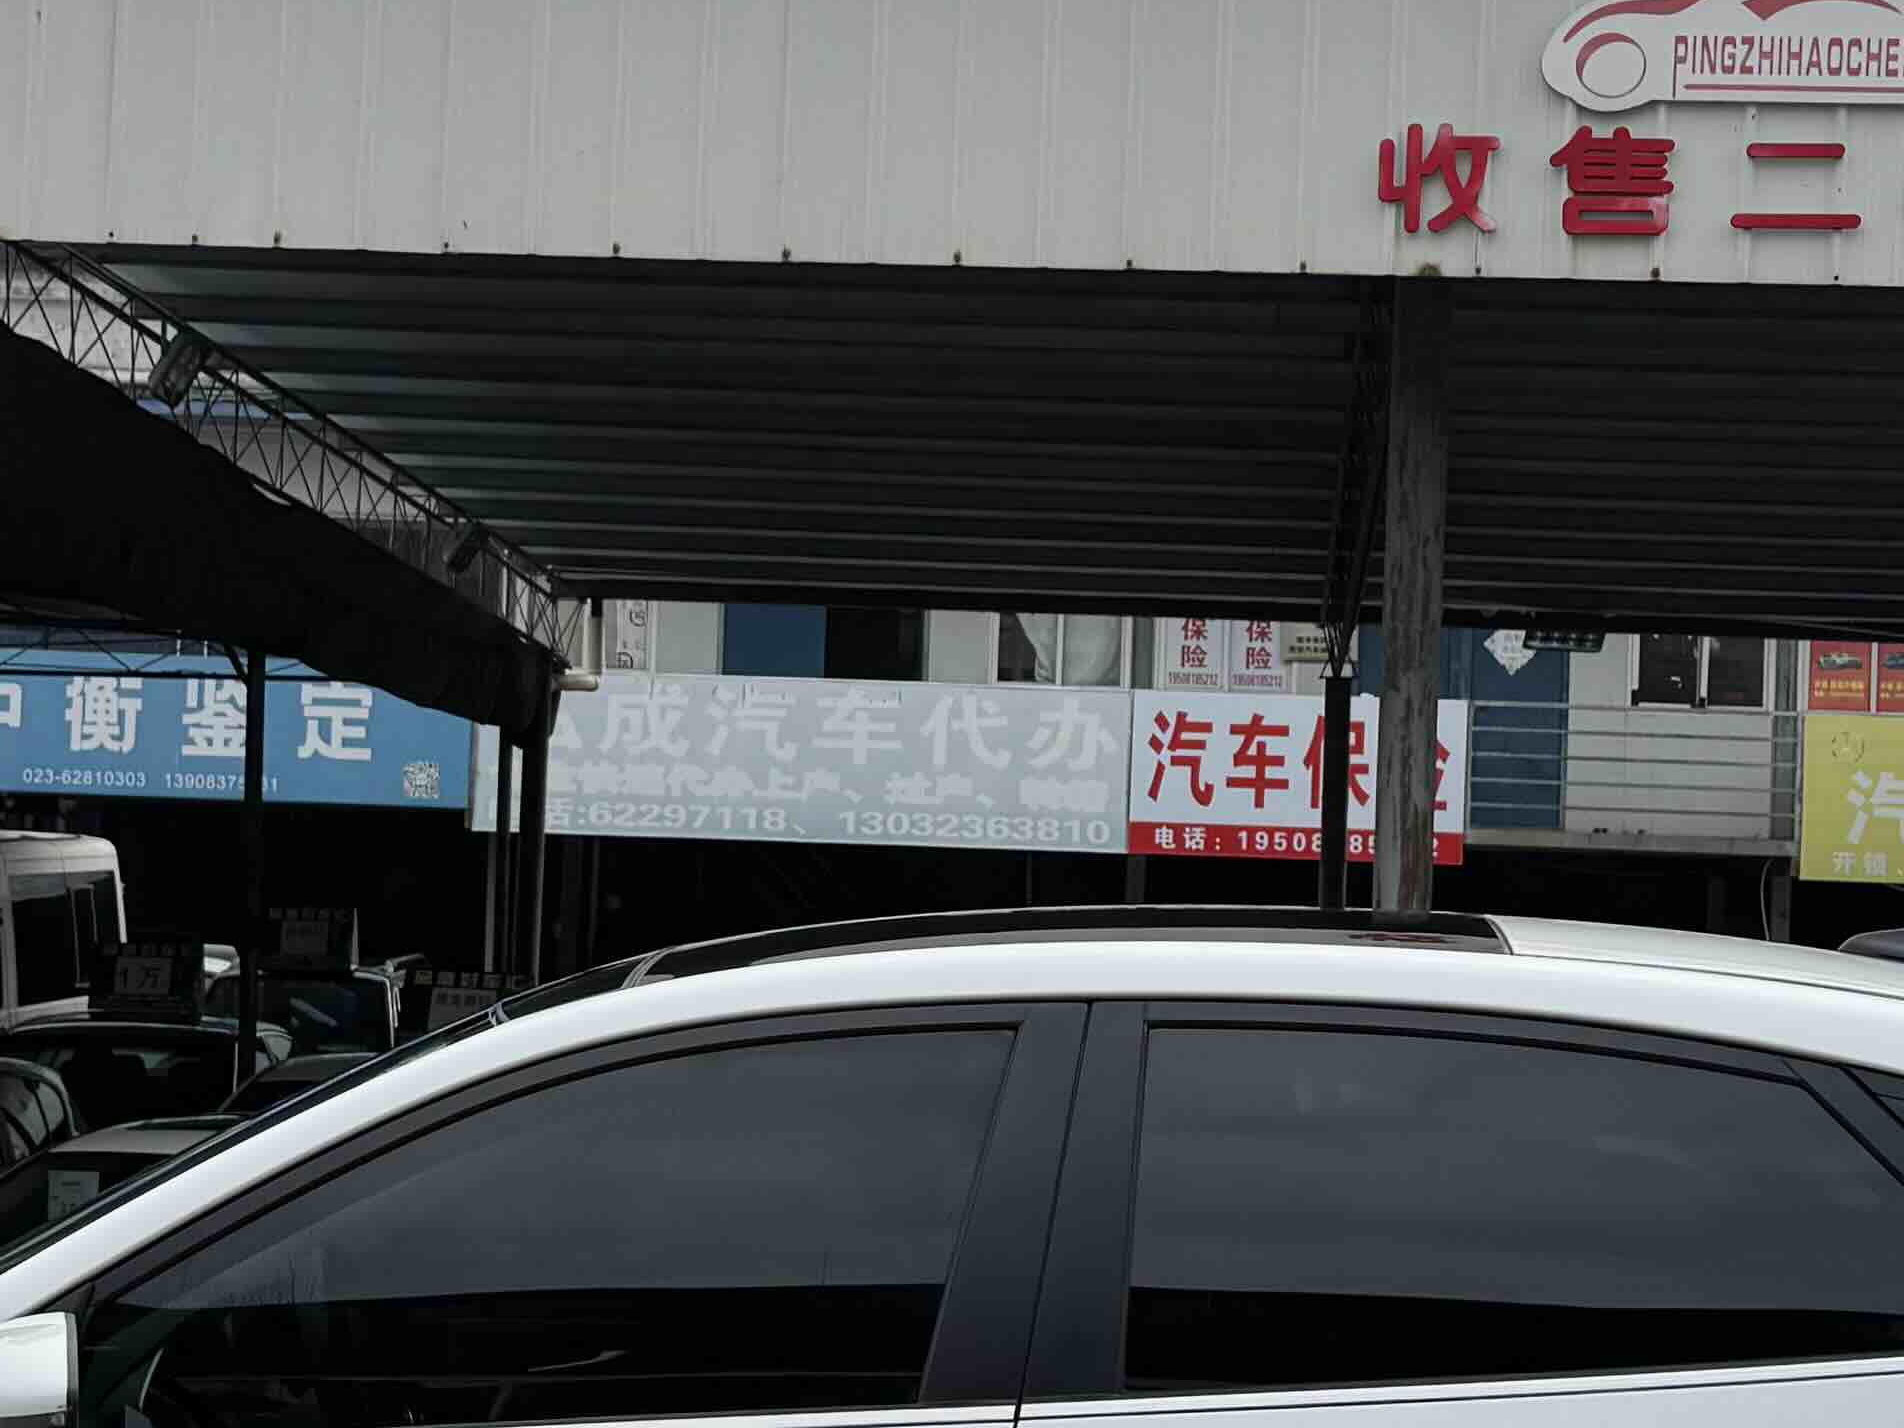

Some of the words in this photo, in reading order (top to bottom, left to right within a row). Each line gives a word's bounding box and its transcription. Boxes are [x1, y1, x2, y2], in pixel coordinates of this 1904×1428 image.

[1147, 711, 1450, 810] 汽车保
[22, 768, 147, 788] 023-62810303
[839, 811, 1110, 845] 13032363810
